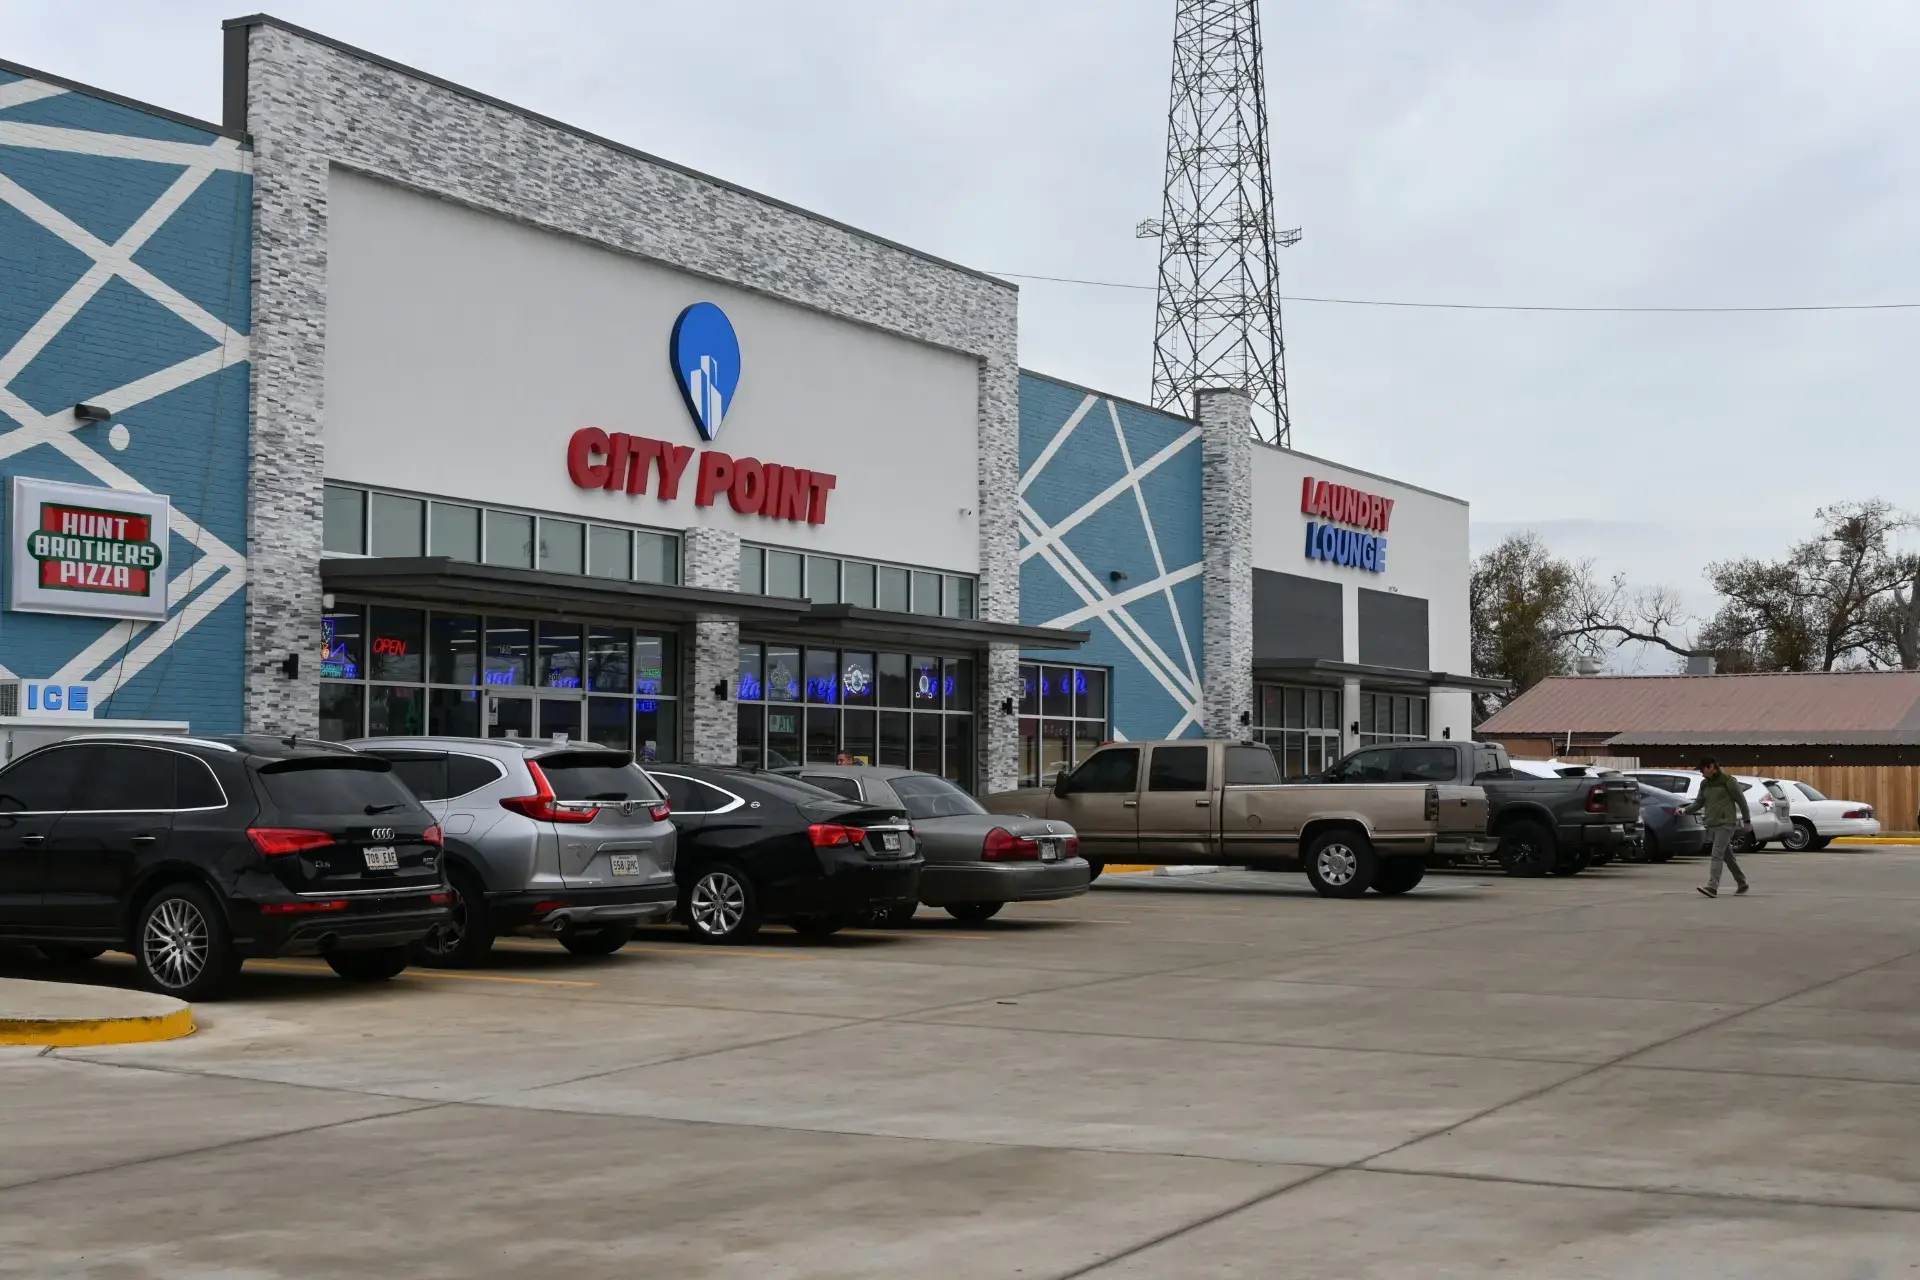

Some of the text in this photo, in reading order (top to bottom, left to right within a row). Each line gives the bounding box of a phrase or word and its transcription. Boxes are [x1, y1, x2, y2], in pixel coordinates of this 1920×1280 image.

[567, 427, 836, 524] CITY POINT
[1301, 477, 1394, 532] LAUNDRY
[62, 512, 128, 540] HUNT
[35, 535, 155, 566] BROTHERS
[1305, 522, 1387, 572] LOUNGE
[60, 560, 129, 588] PIZZA
[373, 637, 407, 656] OPEN
[28, 684, 88, 711] ICE
[365, 852, 396, 864] 708 EAE
[613, 860, 625, 870] 558
